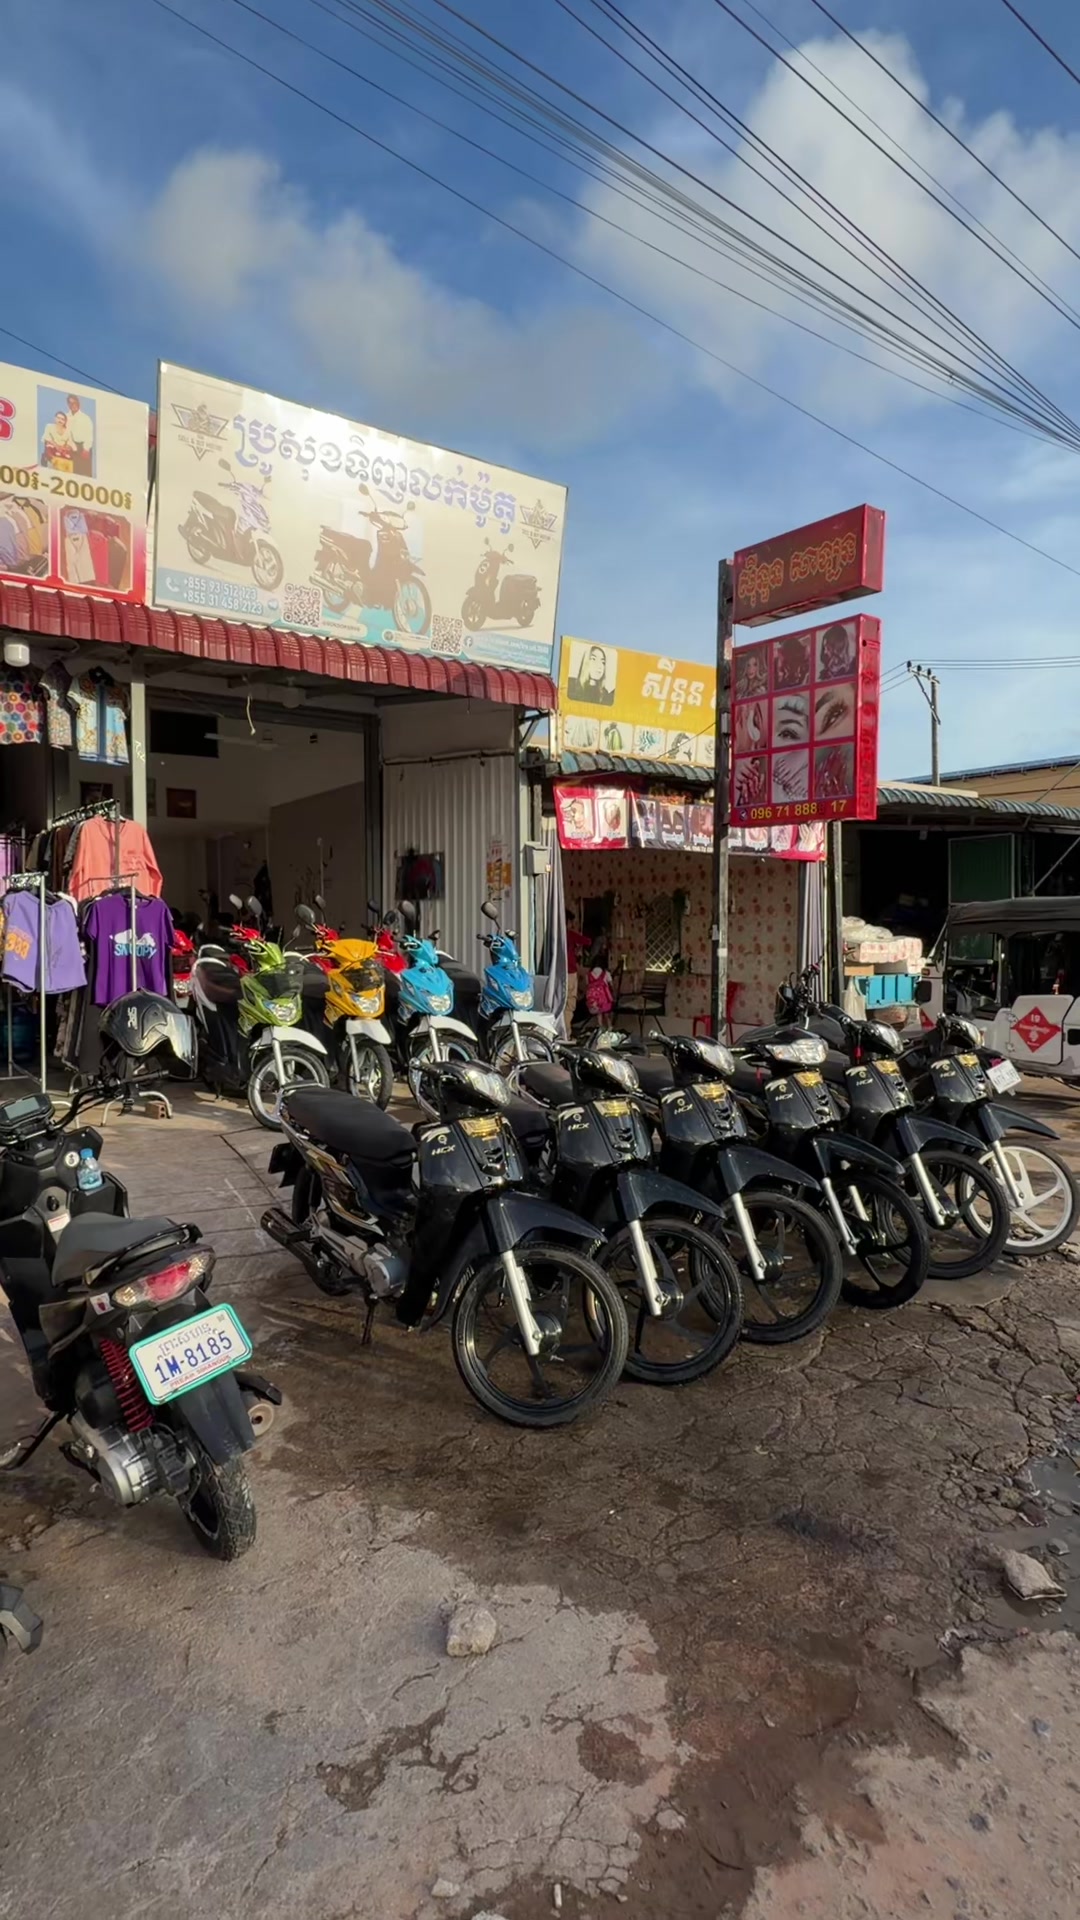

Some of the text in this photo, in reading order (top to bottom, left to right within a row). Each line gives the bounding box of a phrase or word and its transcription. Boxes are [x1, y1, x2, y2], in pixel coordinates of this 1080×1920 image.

[750, 800, 847, 820] 096 71 888 17
